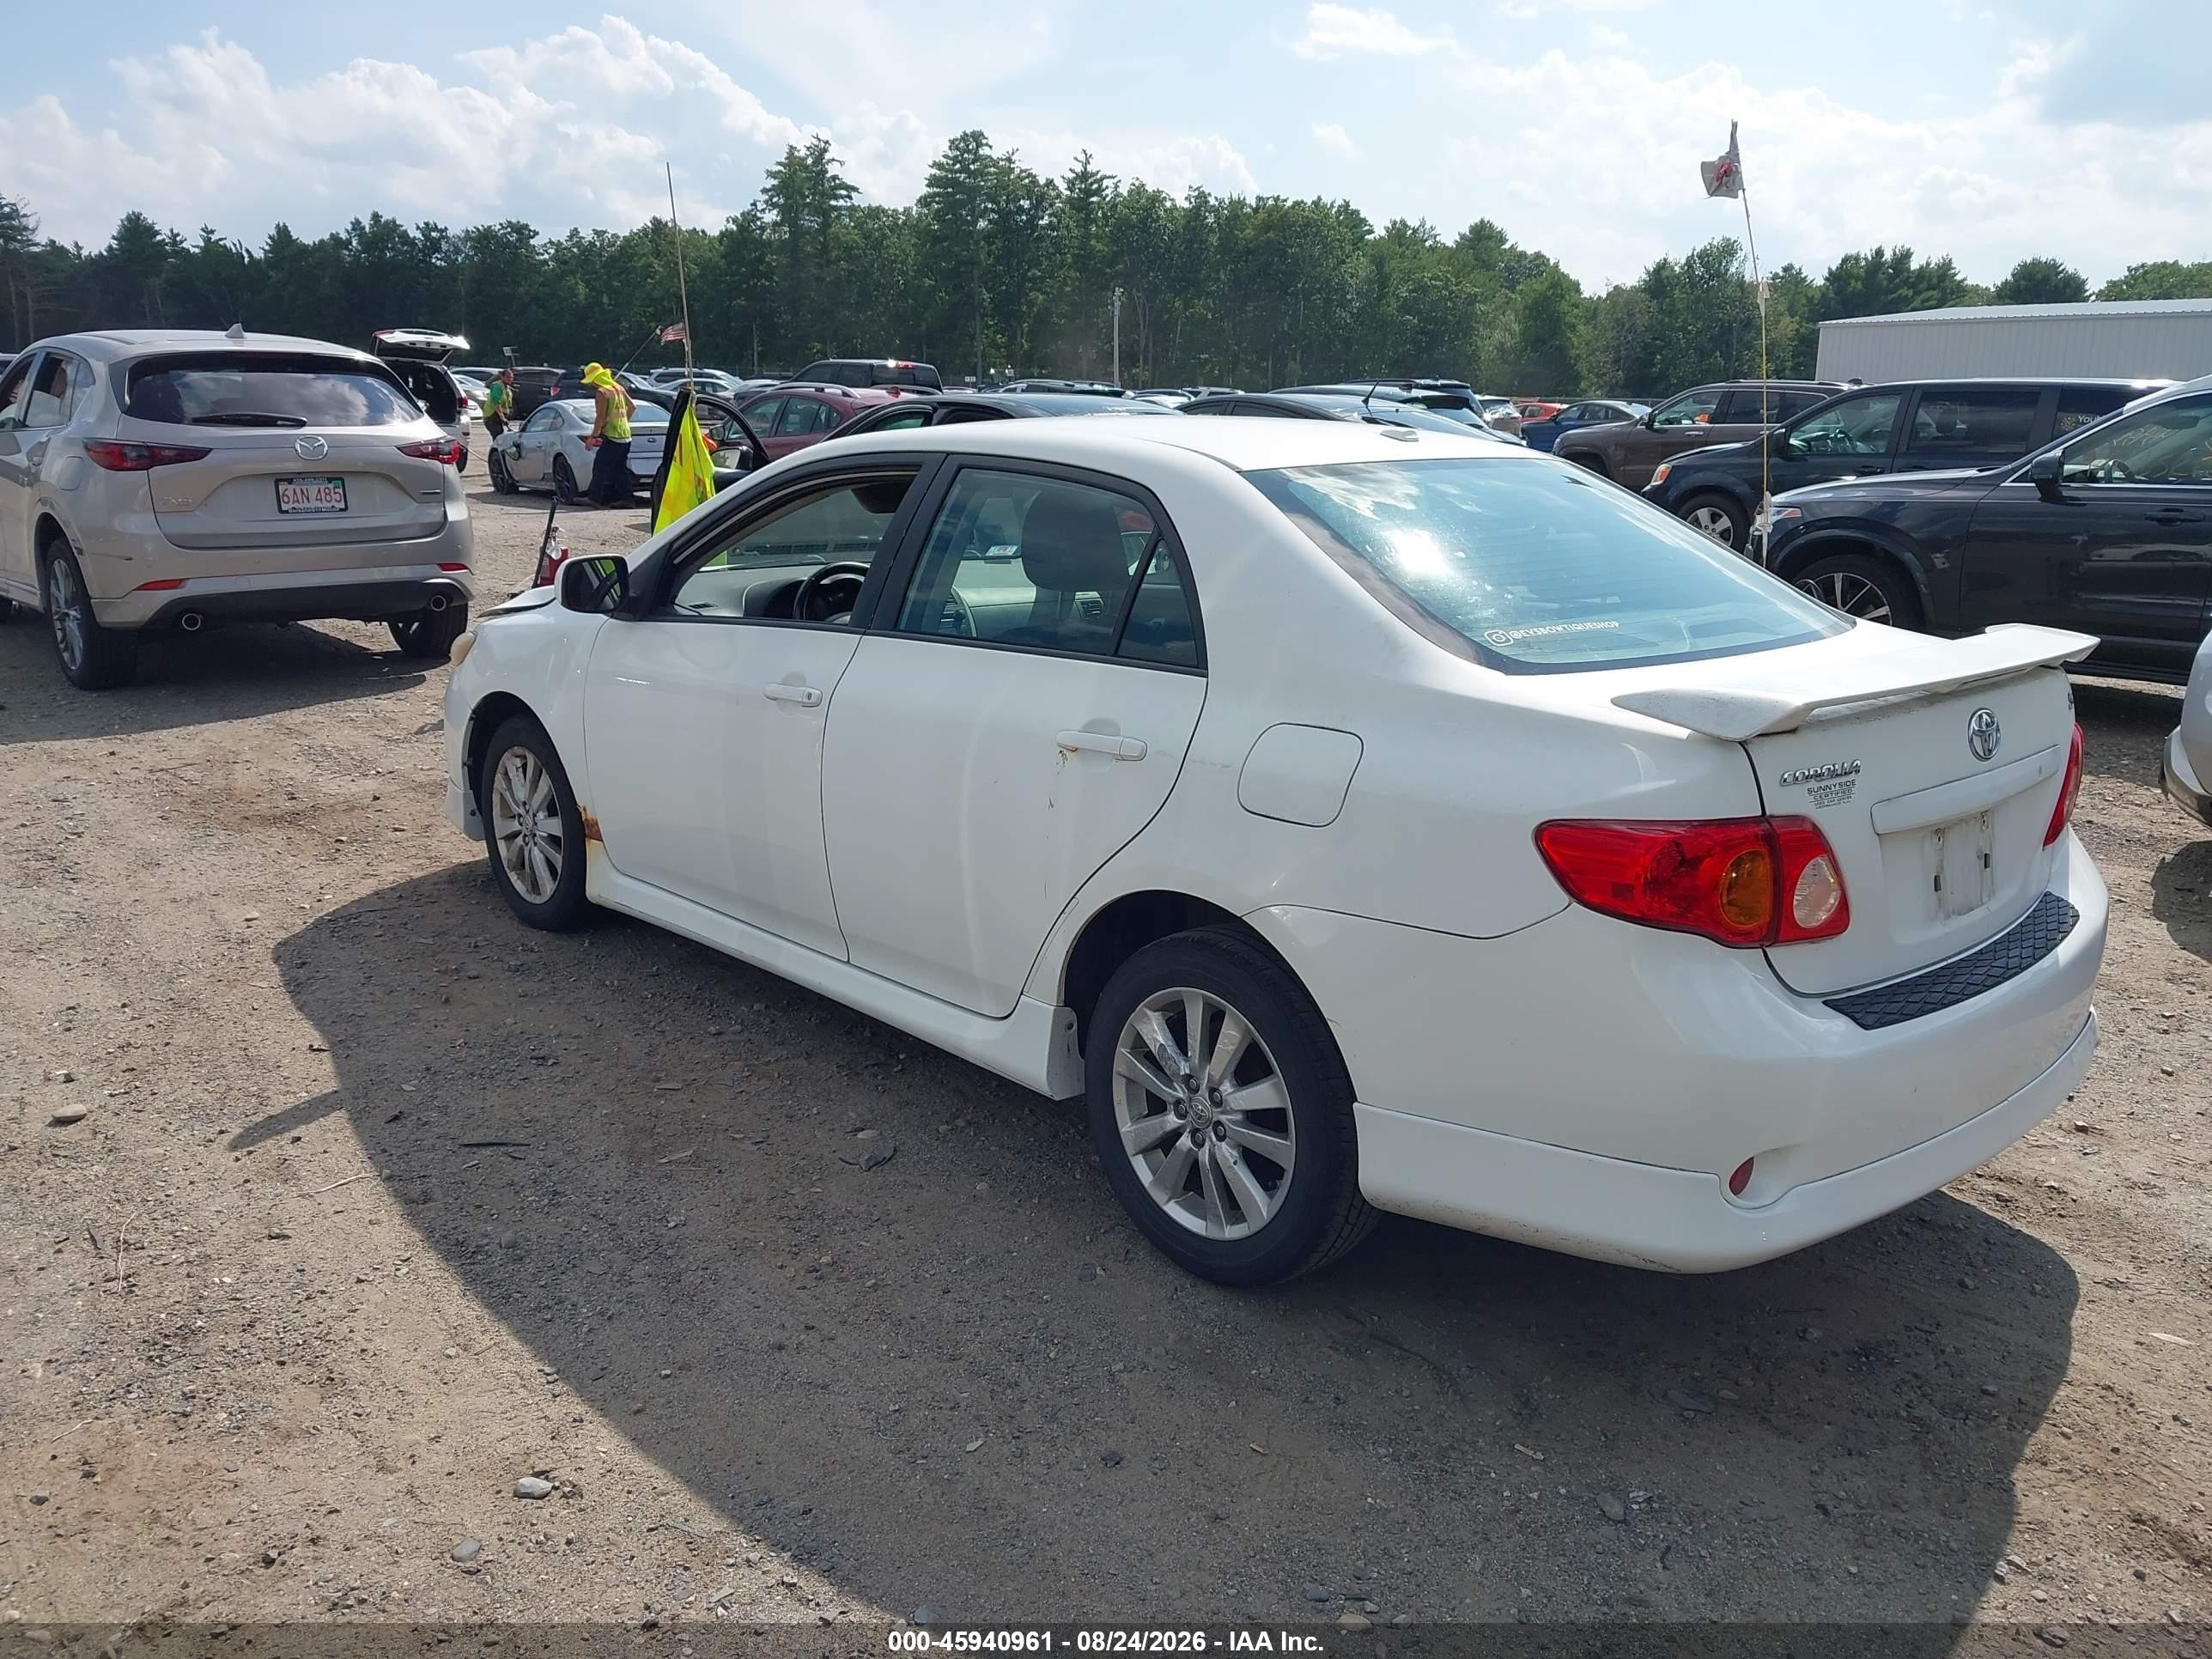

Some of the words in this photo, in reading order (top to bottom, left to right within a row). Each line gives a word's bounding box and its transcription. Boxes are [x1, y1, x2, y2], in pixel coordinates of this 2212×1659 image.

[281, 487, 310, 505] 6AN
[314, 487, 343, 503] 485
[1779, 759, 1861, 787] COROLLA
[1807, 779, 1856, 794] SUNNYSIDE
[1813, 788, 1853, 800] CERTIFIED
